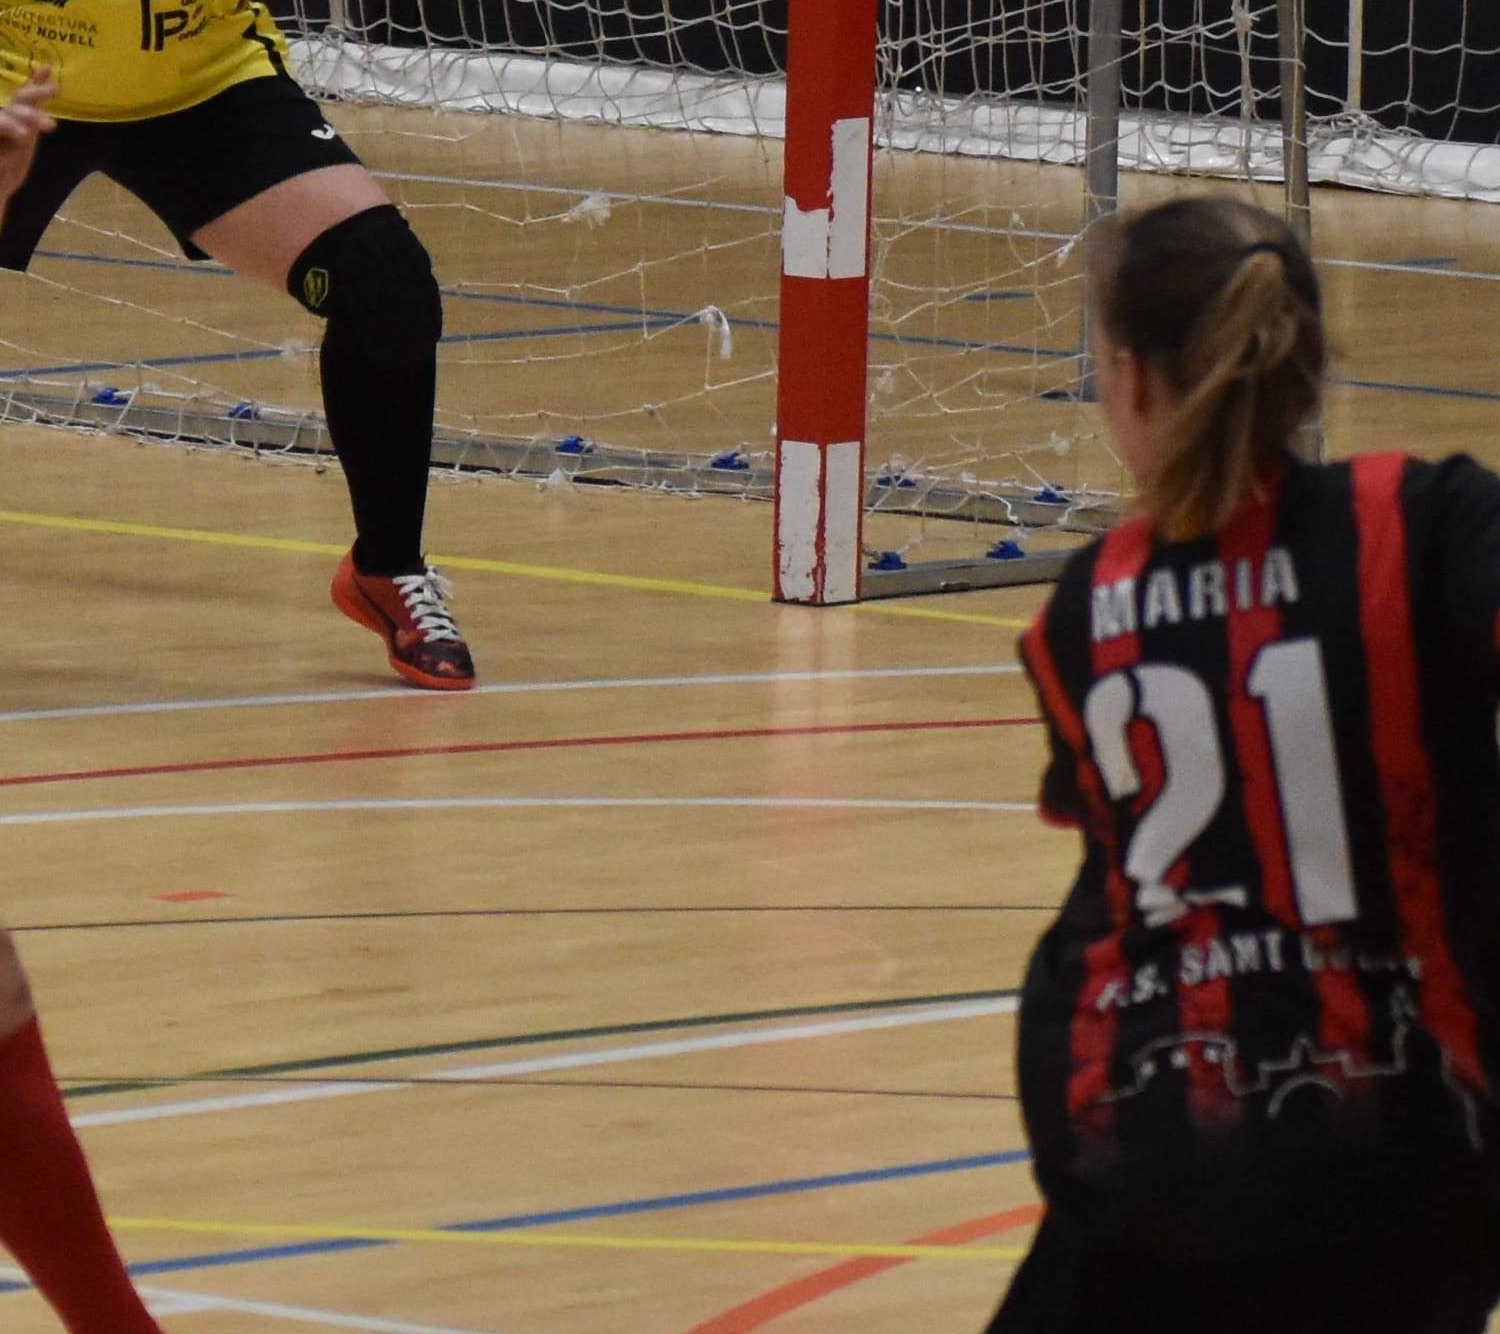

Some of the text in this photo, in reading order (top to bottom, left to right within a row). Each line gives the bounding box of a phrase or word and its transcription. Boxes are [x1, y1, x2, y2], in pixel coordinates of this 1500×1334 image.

[37, 26, 96, 49] NOVELL
[1091, 546, 1299, 644] MARIA
[1085, 637, 1358, 928] 21
[1180, 929, 1283, 986] SANT
